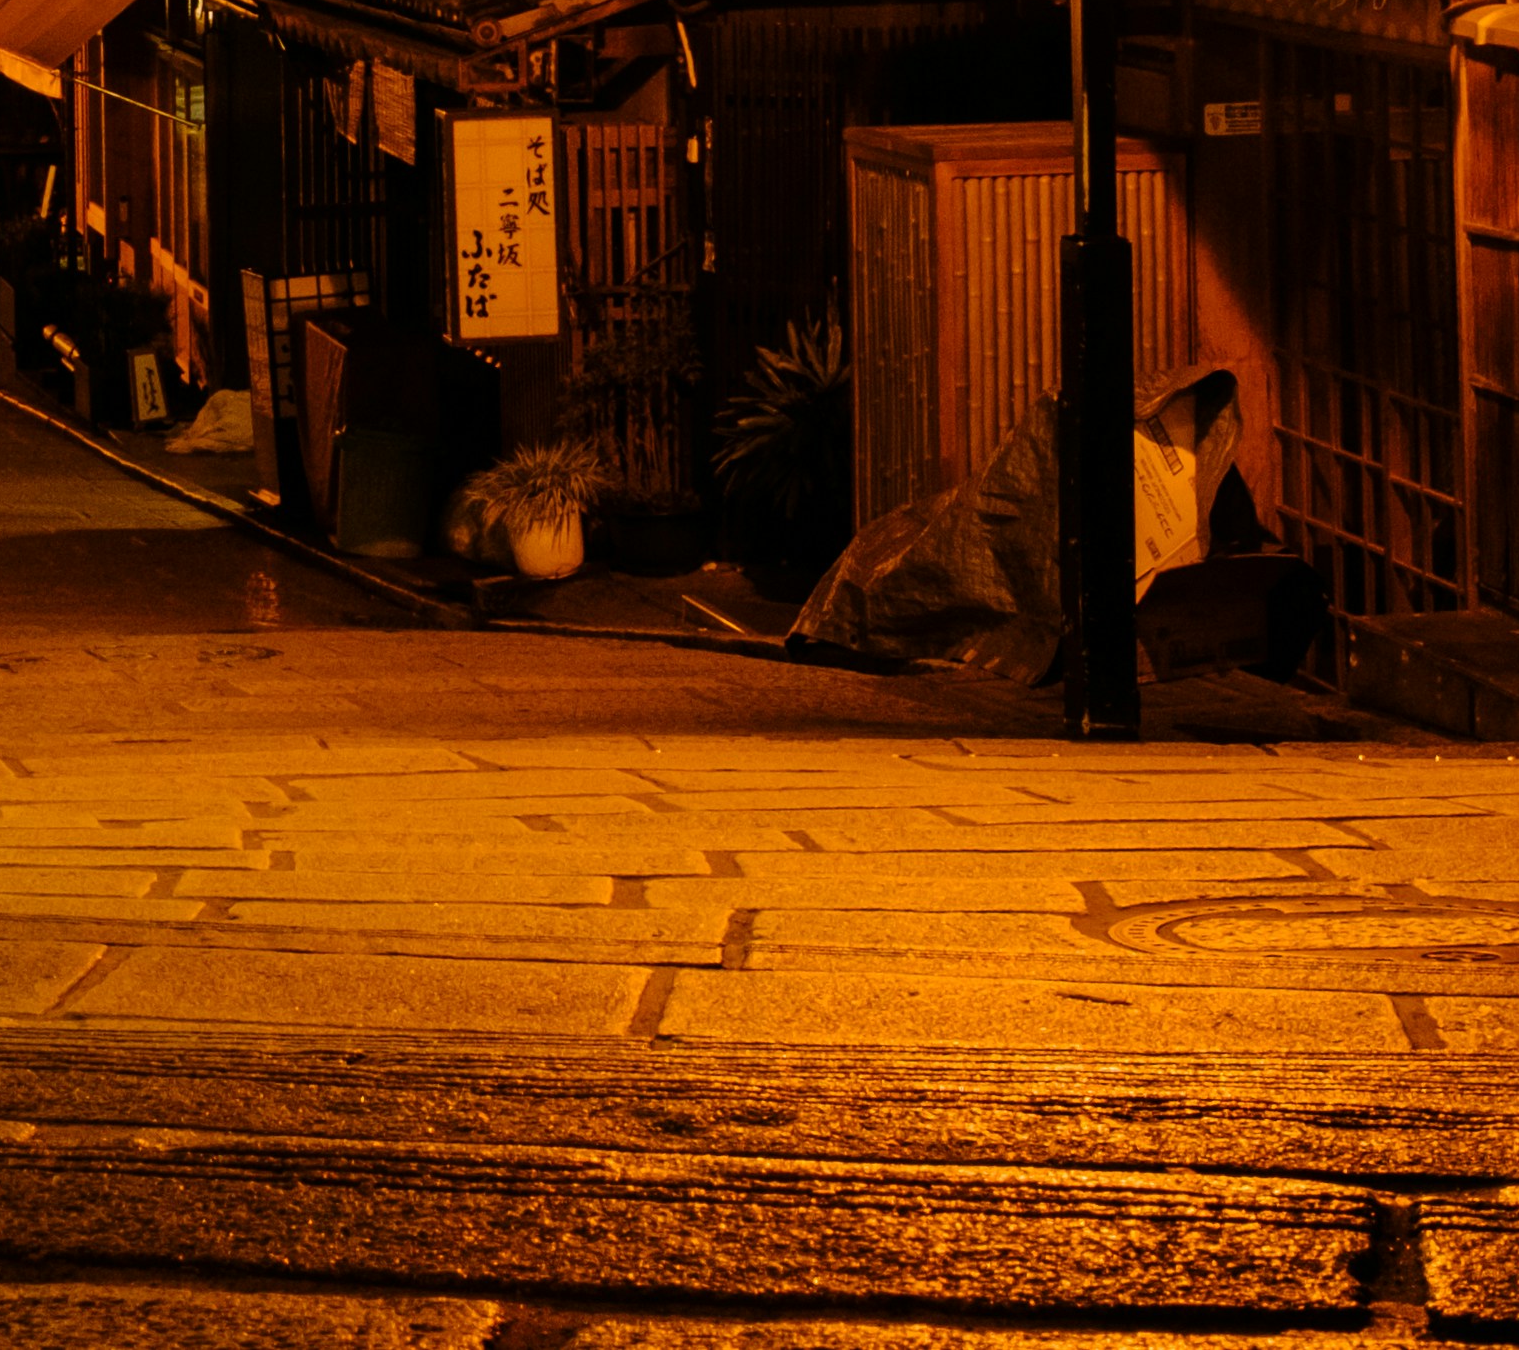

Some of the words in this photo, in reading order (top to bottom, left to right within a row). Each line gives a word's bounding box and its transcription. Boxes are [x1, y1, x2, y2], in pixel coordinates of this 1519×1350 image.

[526, 135, 551, 216] そば処
[498, 187, 522, 268] 二寧坂
[462, 230, 497, 318] ふたば
